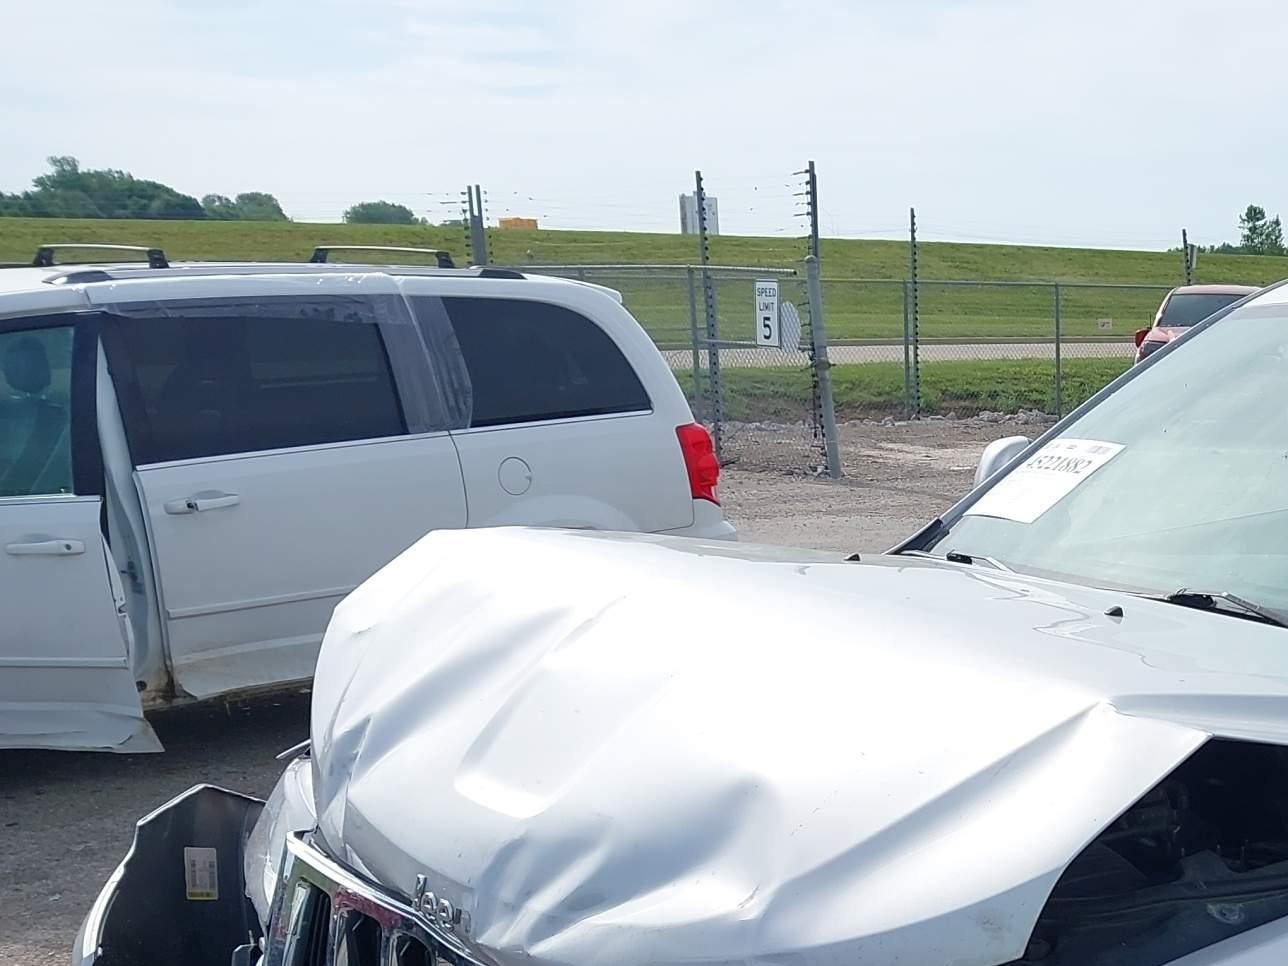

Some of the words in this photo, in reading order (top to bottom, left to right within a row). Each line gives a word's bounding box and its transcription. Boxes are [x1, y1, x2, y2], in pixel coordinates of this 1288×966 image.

[757, 287, 776, 297] SPEED
[758, 302, 774, 312] LIMIT
[762, 316, 772, 340] 5
